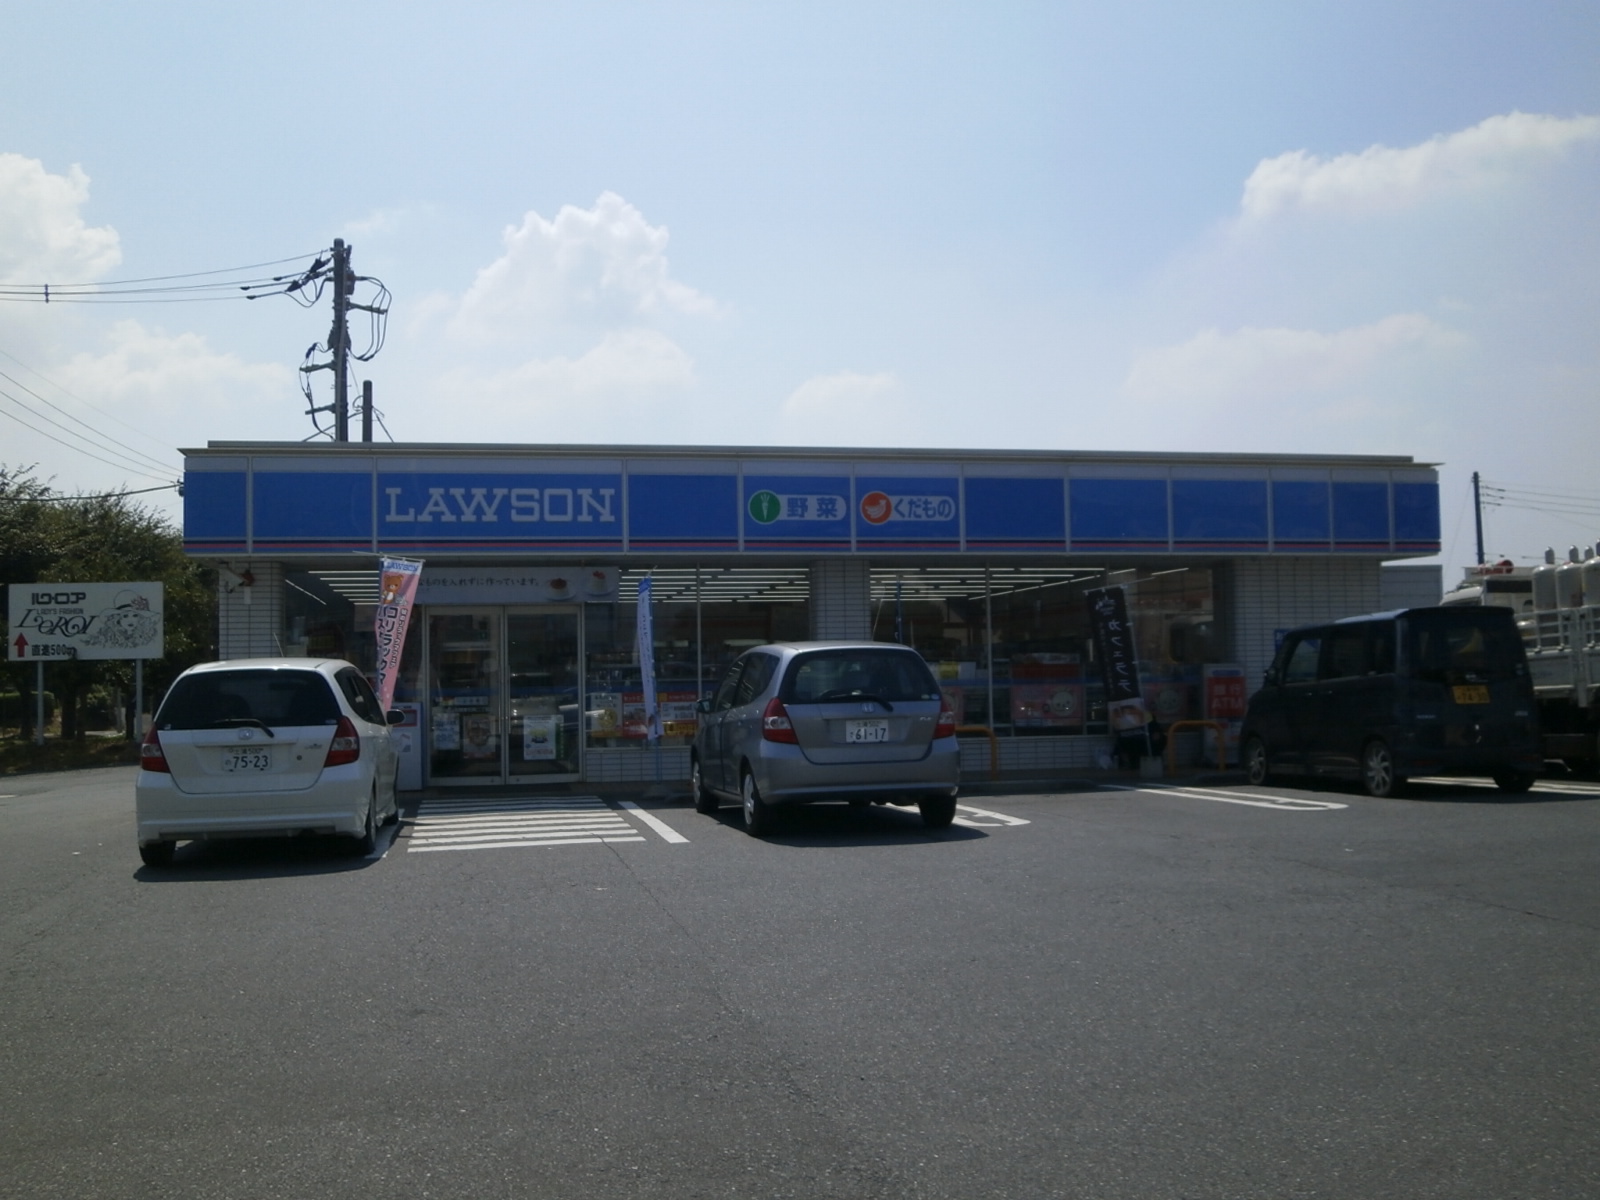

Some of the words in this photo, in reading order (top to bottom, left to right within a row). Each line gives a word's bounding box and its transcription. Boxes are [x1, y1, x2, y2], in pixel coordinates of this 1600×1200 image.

[385, 487, 616, 523] LAWSON
[787, 497, 838, 520] 野菜
[894, 498, 952, 519] くだもの
[1108, 619, 1131, 693] カフェラテ
[1211, 697, 1243, 709] ATM
[856, 728, 886, 740] 61-17
[233, 755, 268, 768] 75-23
